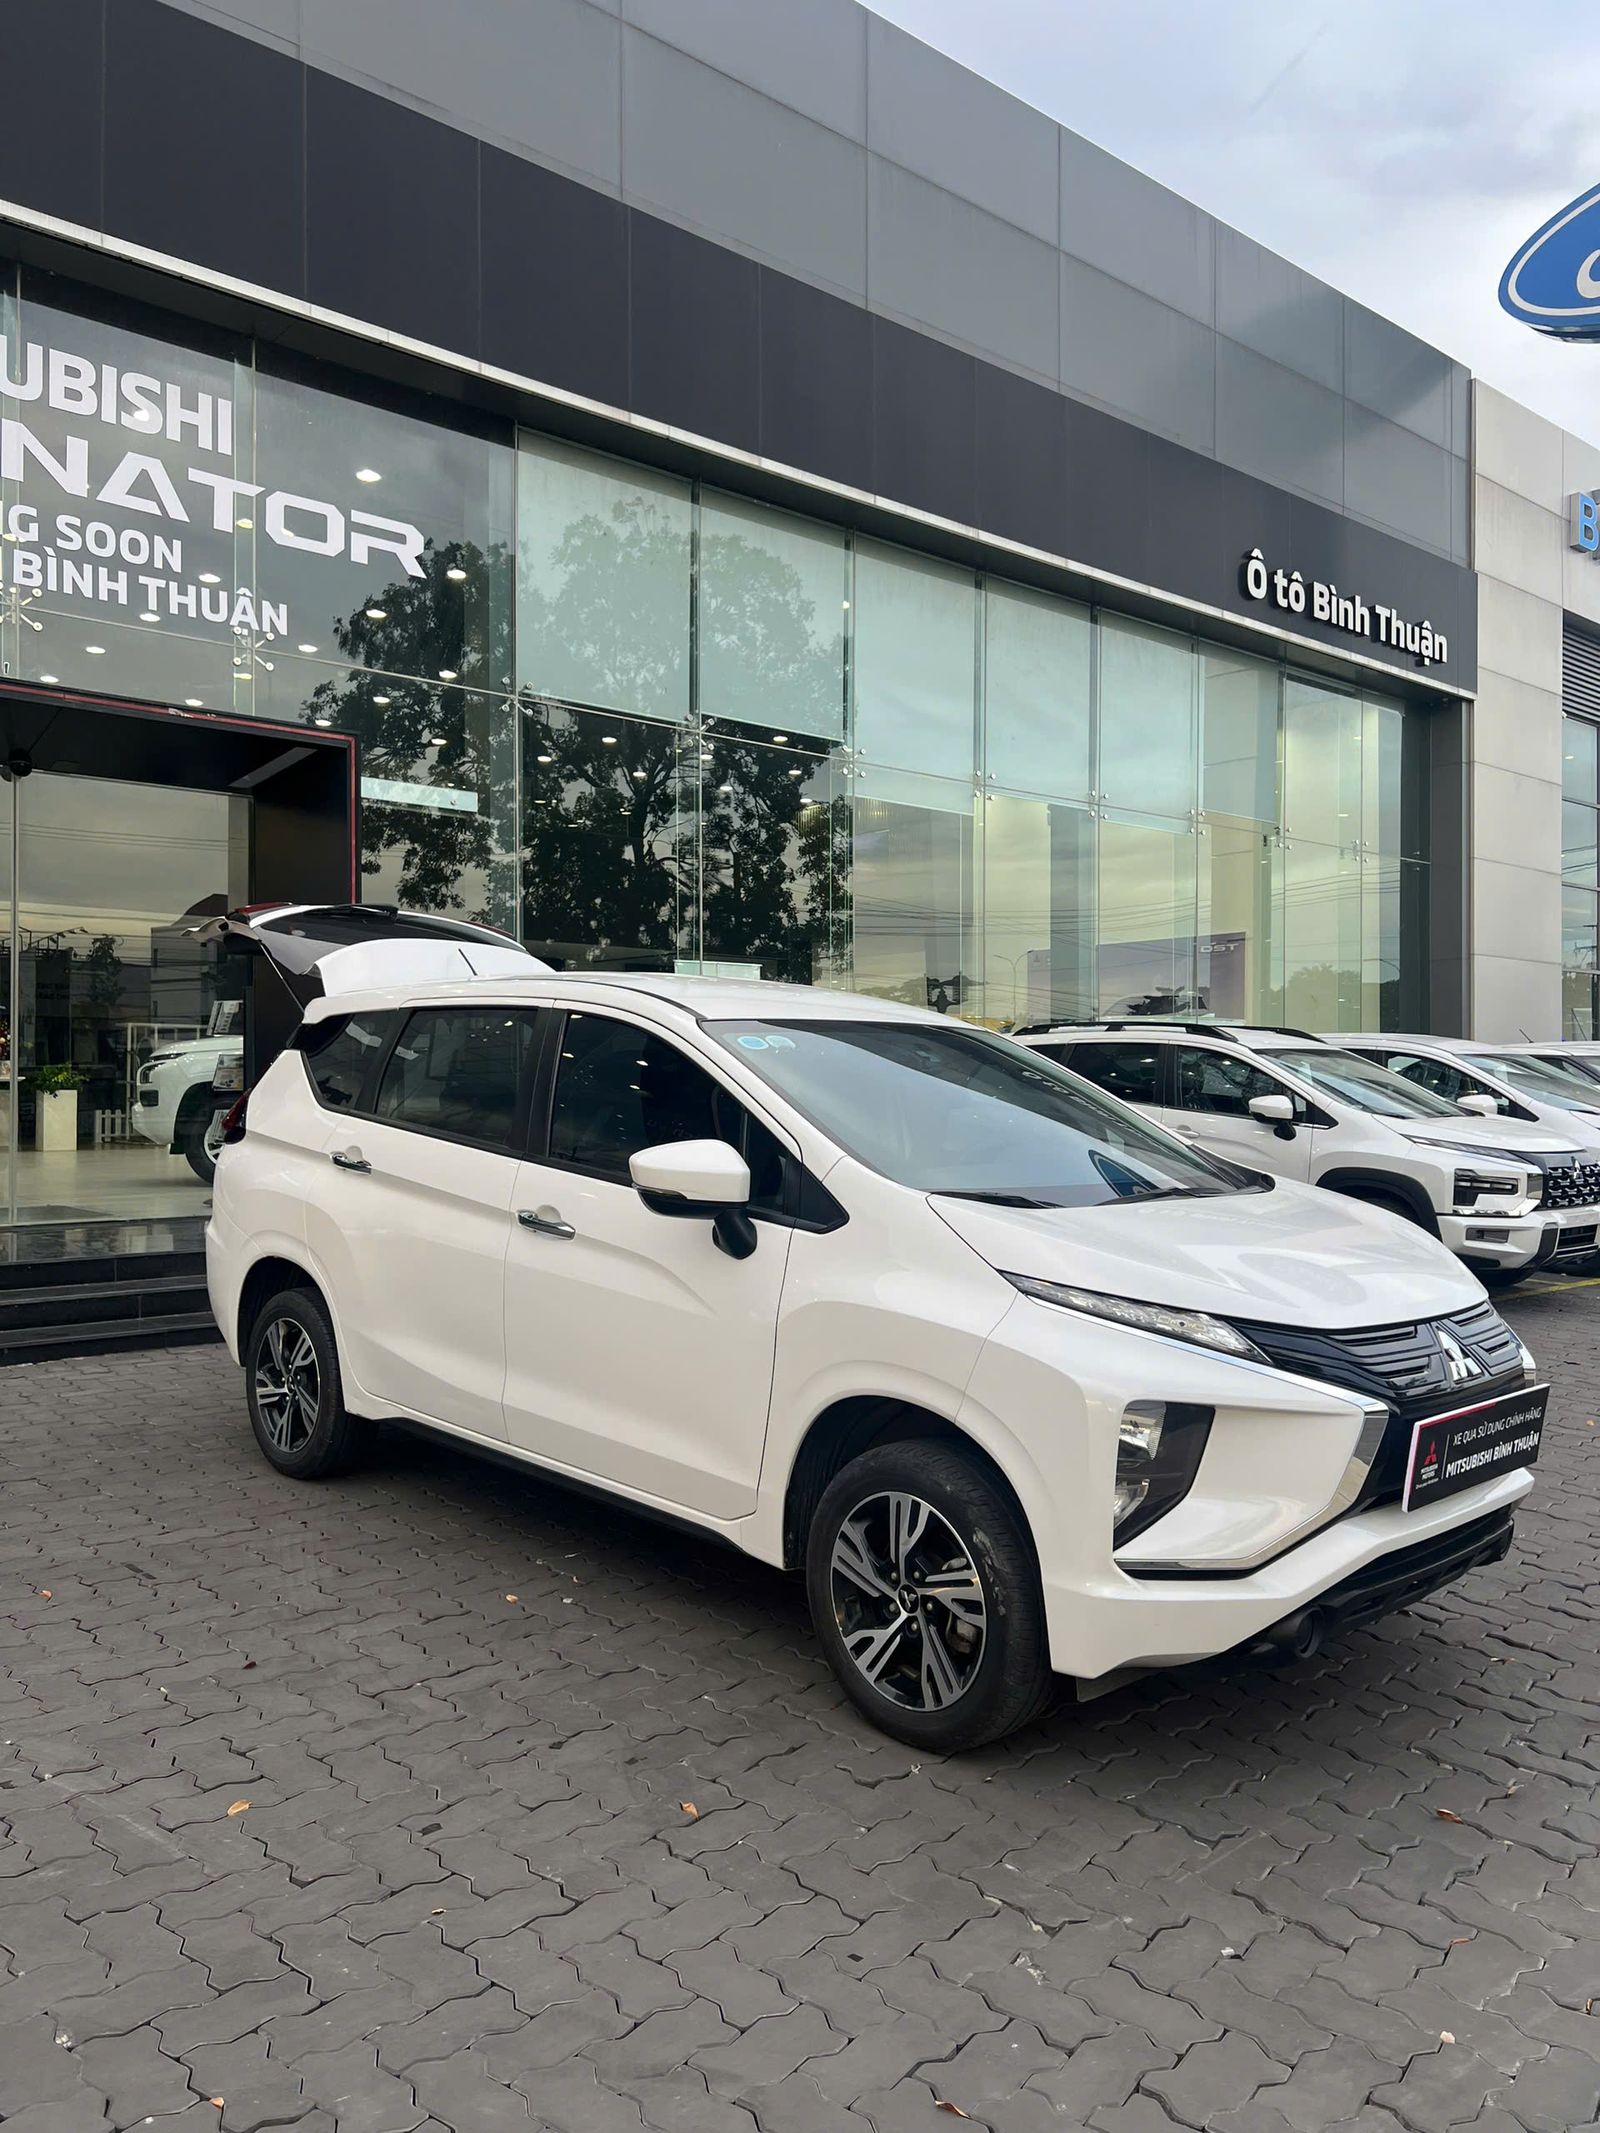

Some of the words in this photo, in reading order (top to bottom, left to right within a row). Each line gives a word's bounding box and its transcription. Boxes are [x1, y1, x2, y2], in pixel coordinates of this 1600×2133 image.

[0, 334, 232, 456] UBISHI
[0, 501, 39, 542] G
[55, 514, 182, 573] SOON
[1571, 490, 1600, 554] B
[13, 546, 128, 605] BÌNH
[138, 574, 288, 636] THUẬN
[1247, 547, 1268, 600] Ô
[1274, 568, 1306, 613] tô
[1313, 581, 1370, 636] Bình
[1375, 604, 1448, 666] Thuận
[1445, 1448, 1493, 1478] MITSUBISHI
[1493, 1441, 1513, 1461] BÌNH
[1513, 1430, 1540, 1453] THUẬN
[1453, 1433, 1463, 1446] XE
[1463, 1428, 1477, 1444] QUA
